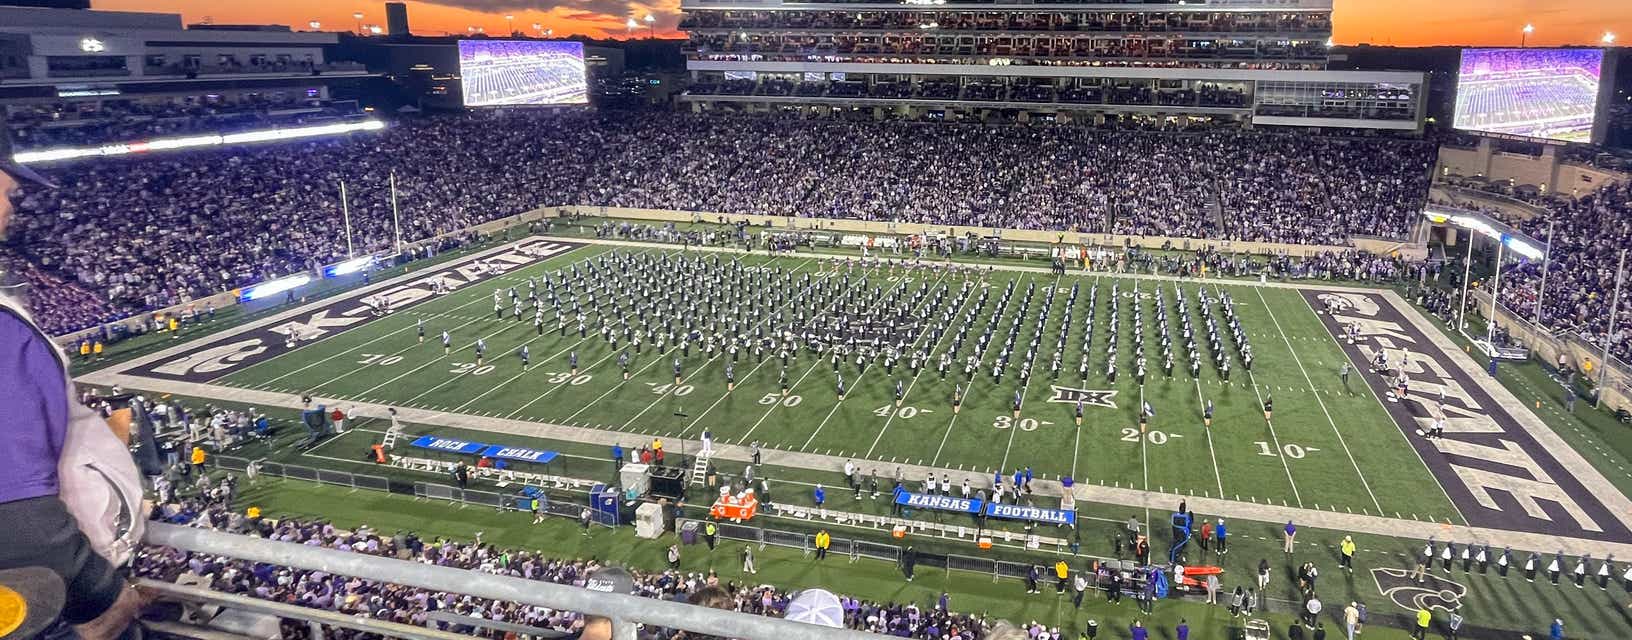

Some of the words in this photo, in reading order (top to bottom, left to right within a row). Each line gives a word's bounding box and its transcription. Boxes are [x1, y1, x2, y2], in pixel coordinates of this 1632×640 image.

[357, 353, 405, 366] 10
[449, 362, 496, 376] 20
[547, 371, 593, 385] 30
[651, 383, 695, 397] 40
[757, 392, 803, 408] 50
[872, 404, 918, 419] 40
[992, 415, 1039, 432] 30
[1120, 427, 1168, 445] 20
[429, 438, 469, 451] ROCK
[496, 447, 546, 460] CHALK
[1253, 441, 1306, 459] 10
[907, 494, 971, 510] KANSAS
[993, 502, 1068, 523] FOOTBALL
